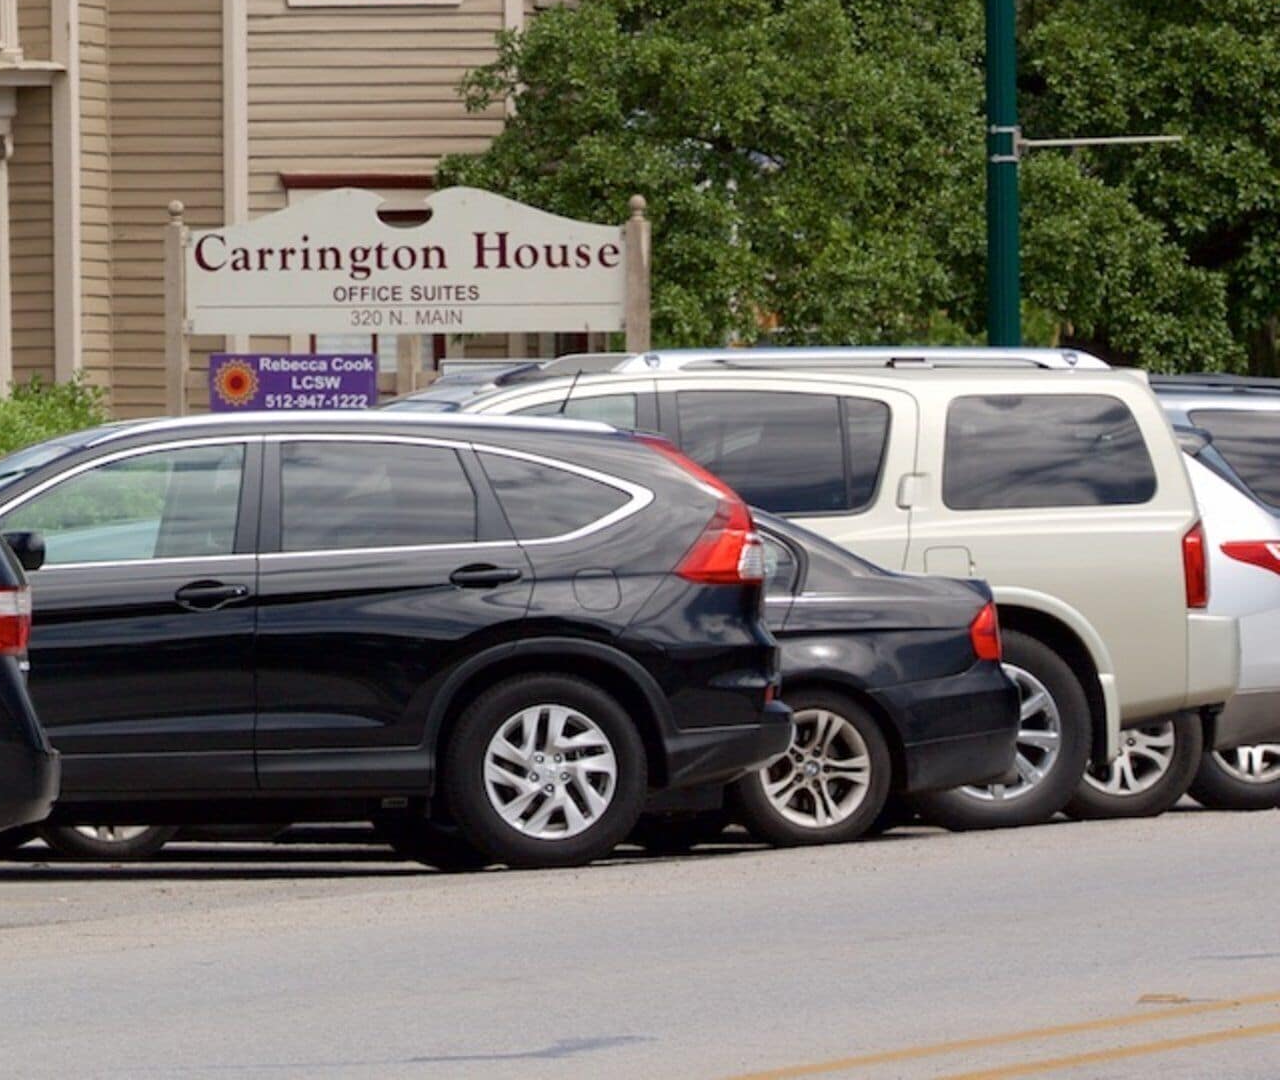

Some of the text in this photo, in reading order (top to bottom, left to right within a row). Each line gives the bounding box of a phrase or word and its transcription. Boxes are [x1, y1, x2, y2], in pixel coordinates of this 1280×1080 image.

[194, 231, 621, 281] Carrington House
[333, 285, 480, 302] OFFICE SUITES
[350, 309, 464, 326] 320 N. MAIN
[259, 358, 374, 372] Rebecca Cook
[291, 376, 341, 390] LCSW
[265, 394, 368, 409] 512-947-1222
